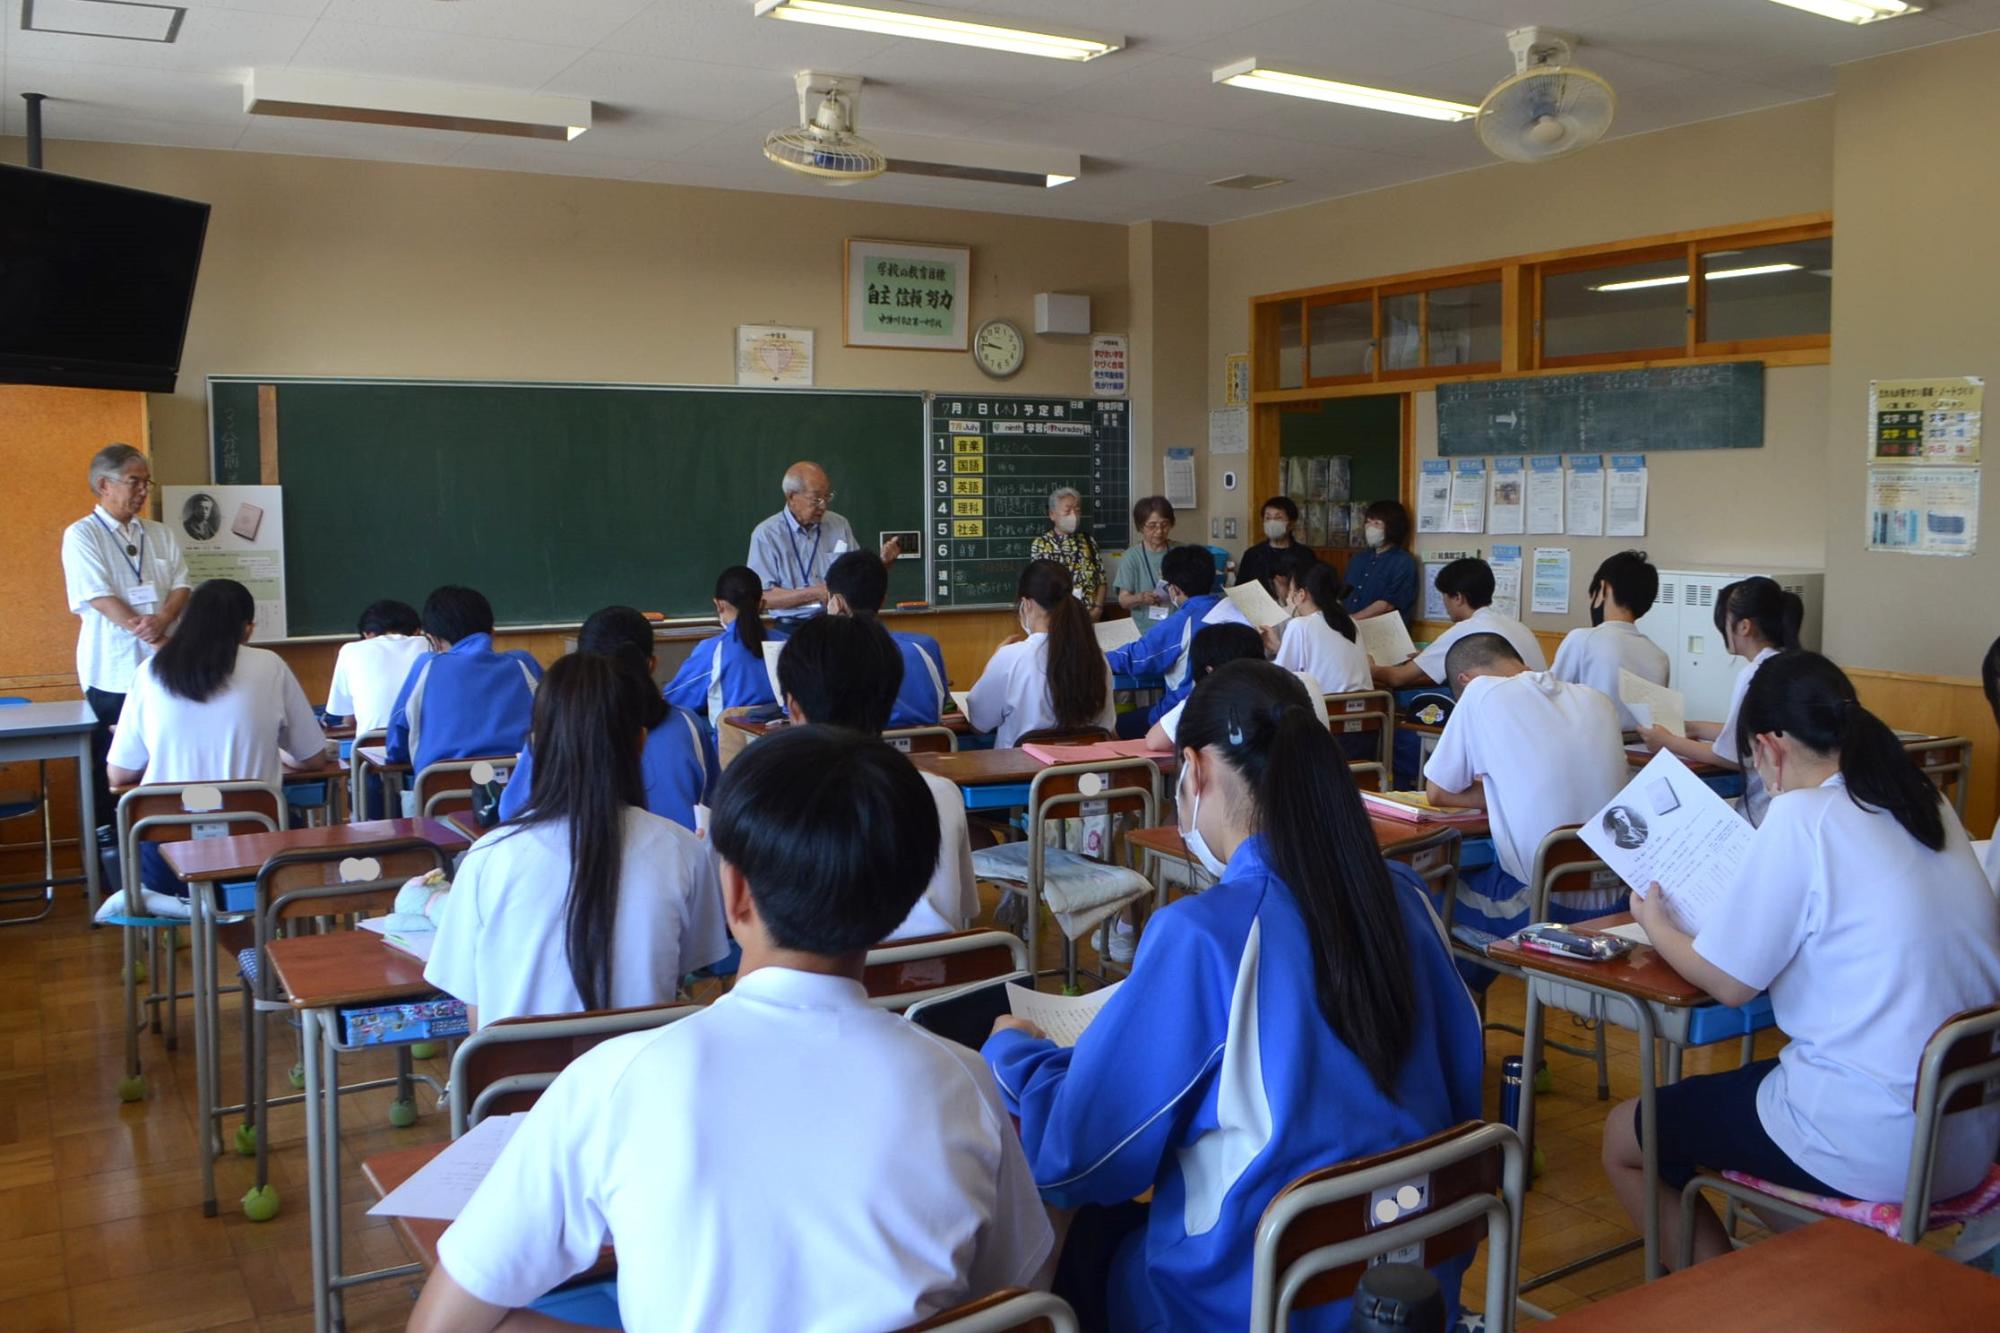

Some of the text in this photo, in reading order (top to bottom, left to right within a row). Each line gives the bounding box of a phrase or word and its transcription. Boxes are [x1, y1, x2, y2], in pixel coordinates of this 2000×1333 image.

[877, 261, 946, 280] 学校の教育目標
[867, 282, 953, 311] 自主 信頼 努力
[1024, 404, 1064, 417] 予定表
[939, 438, 980, 452] 1 音楽
[937, 459, 980, 472] 2 国語
[937, 480, 979, 493] 3 英語
[937, 502, 979, 514] 4 理科
[937, 523, 979, 536] 5 社会
[937, 544, 948, 557] 6
